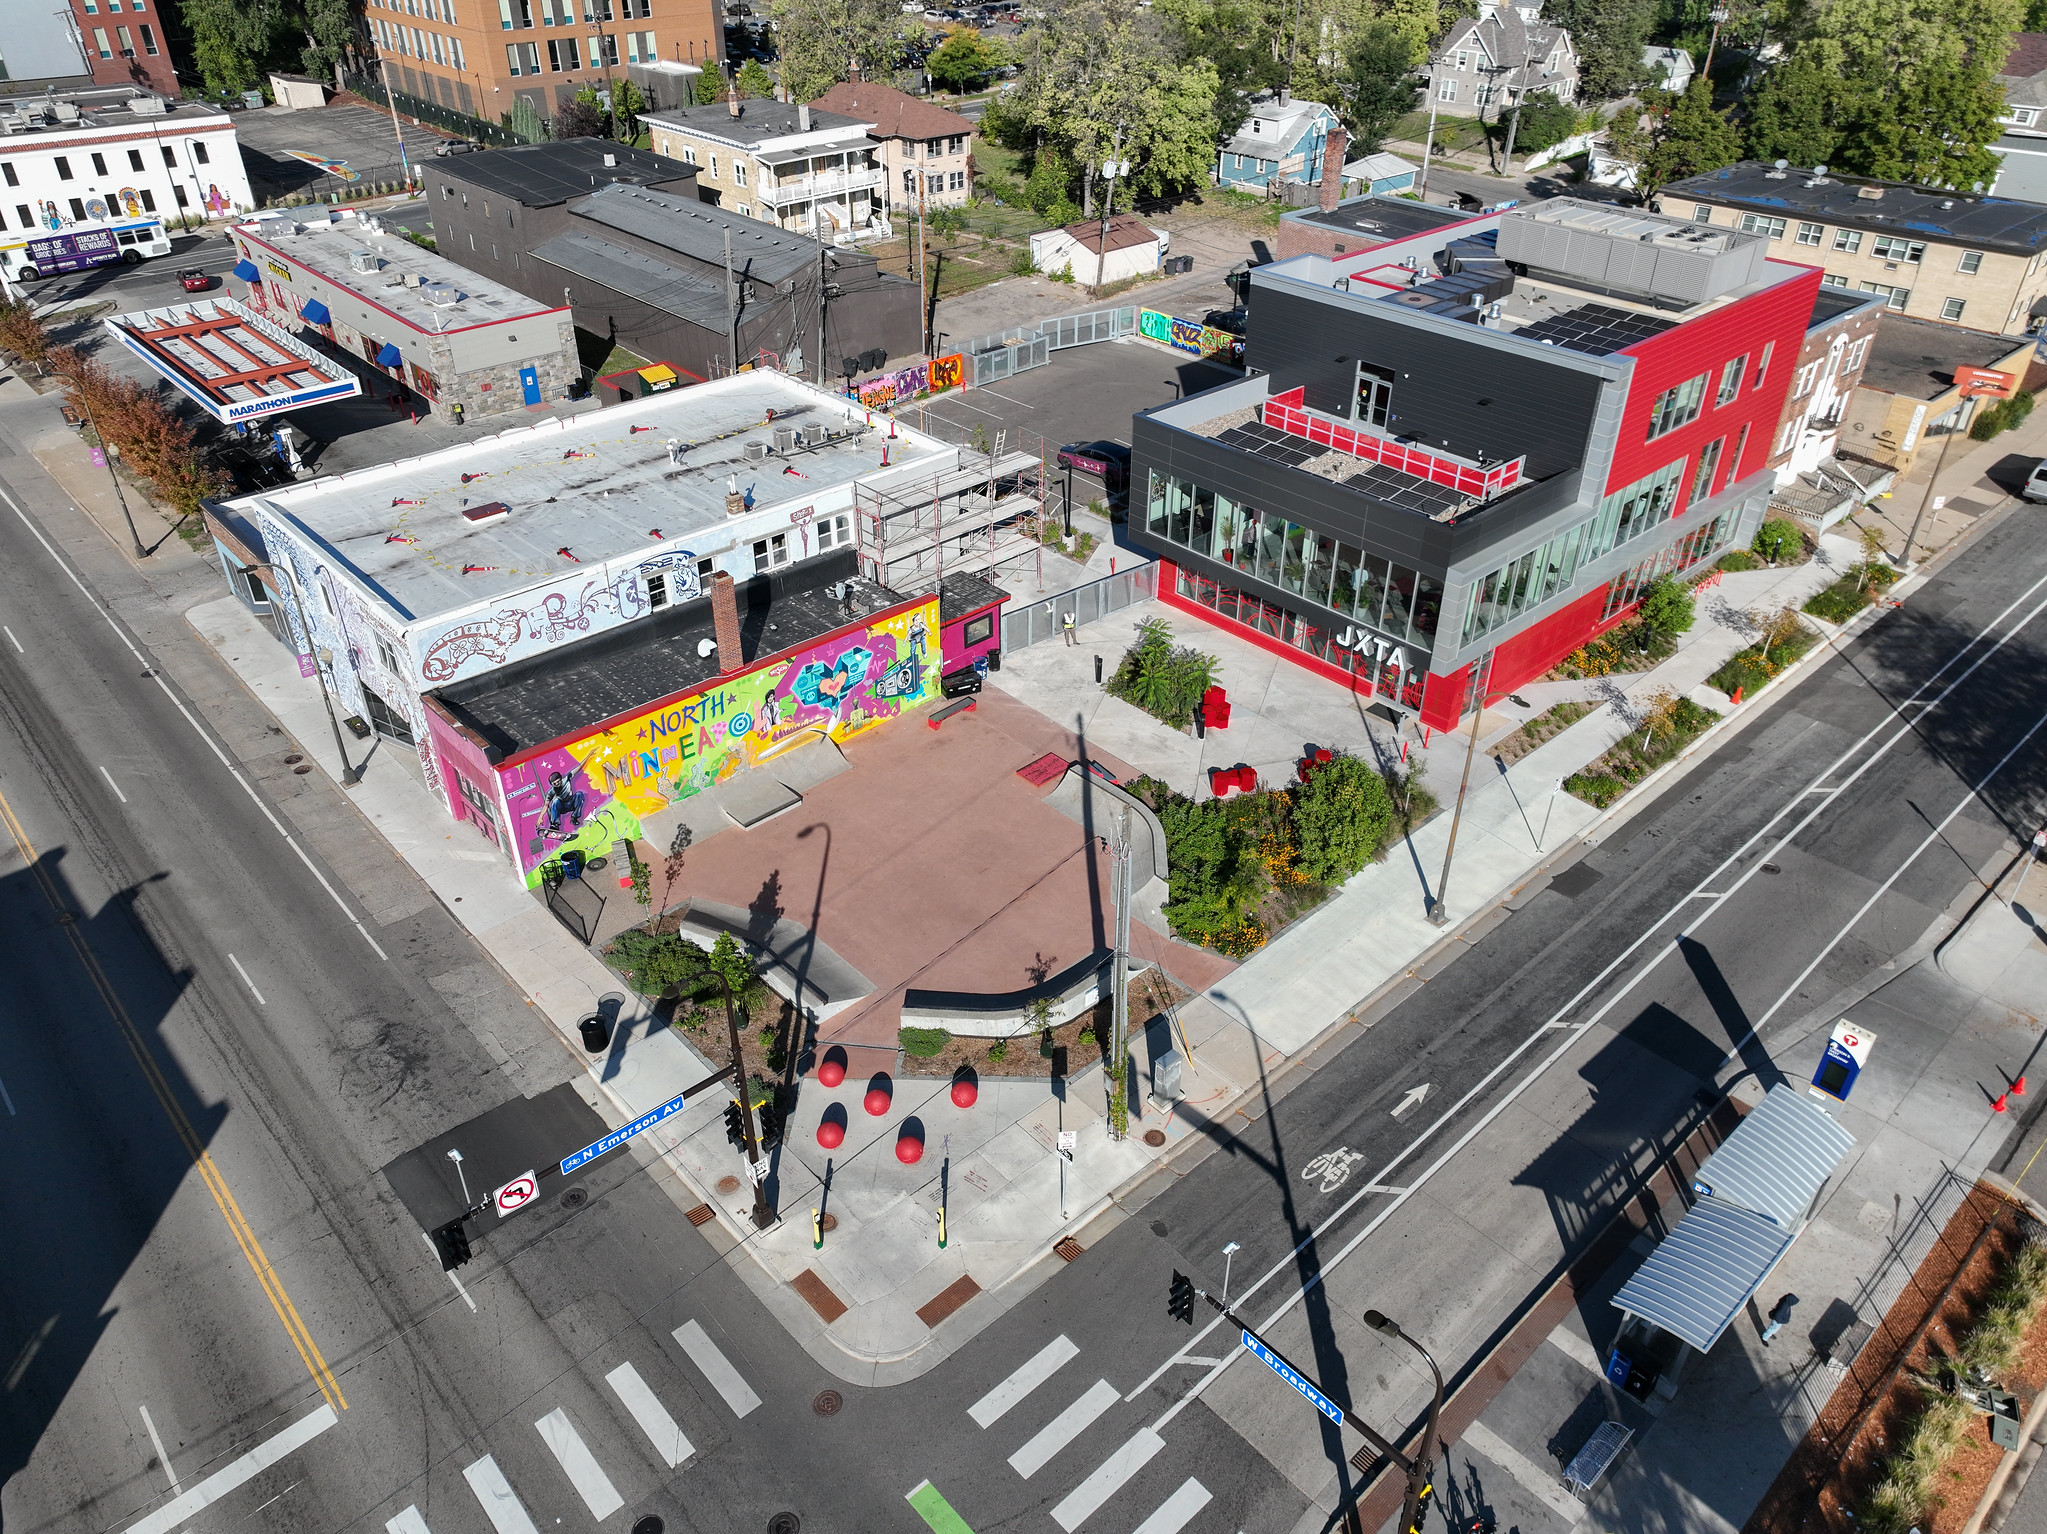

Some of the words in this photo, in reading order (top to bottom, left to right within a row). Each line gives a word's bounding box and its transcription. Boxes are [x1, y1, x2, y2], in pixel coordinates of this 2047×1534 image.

[32, 242, 52, 253] BAGS
[52, 239, 63, 249] OF
[76, 234, 98, 245] STACKS
[99, 232, 108, 241] OF
[79, 239, 111, 252] REWARDS
[35, 249, 67, 259] GROCRIES
[229, 396, 292, 417] MARATHON
[1336, 625, 1410, 672] JXTA
[650, 691, 725, 744] NORTH
[582, 1148, 593, 1160] N
[598, 1114, 658, 1152] Emerson
[663, 1101, 681, 1116] Av
[1247, 1336, 1259, 1351] W
[1264, 1351, 1338, 1418] Broadway
